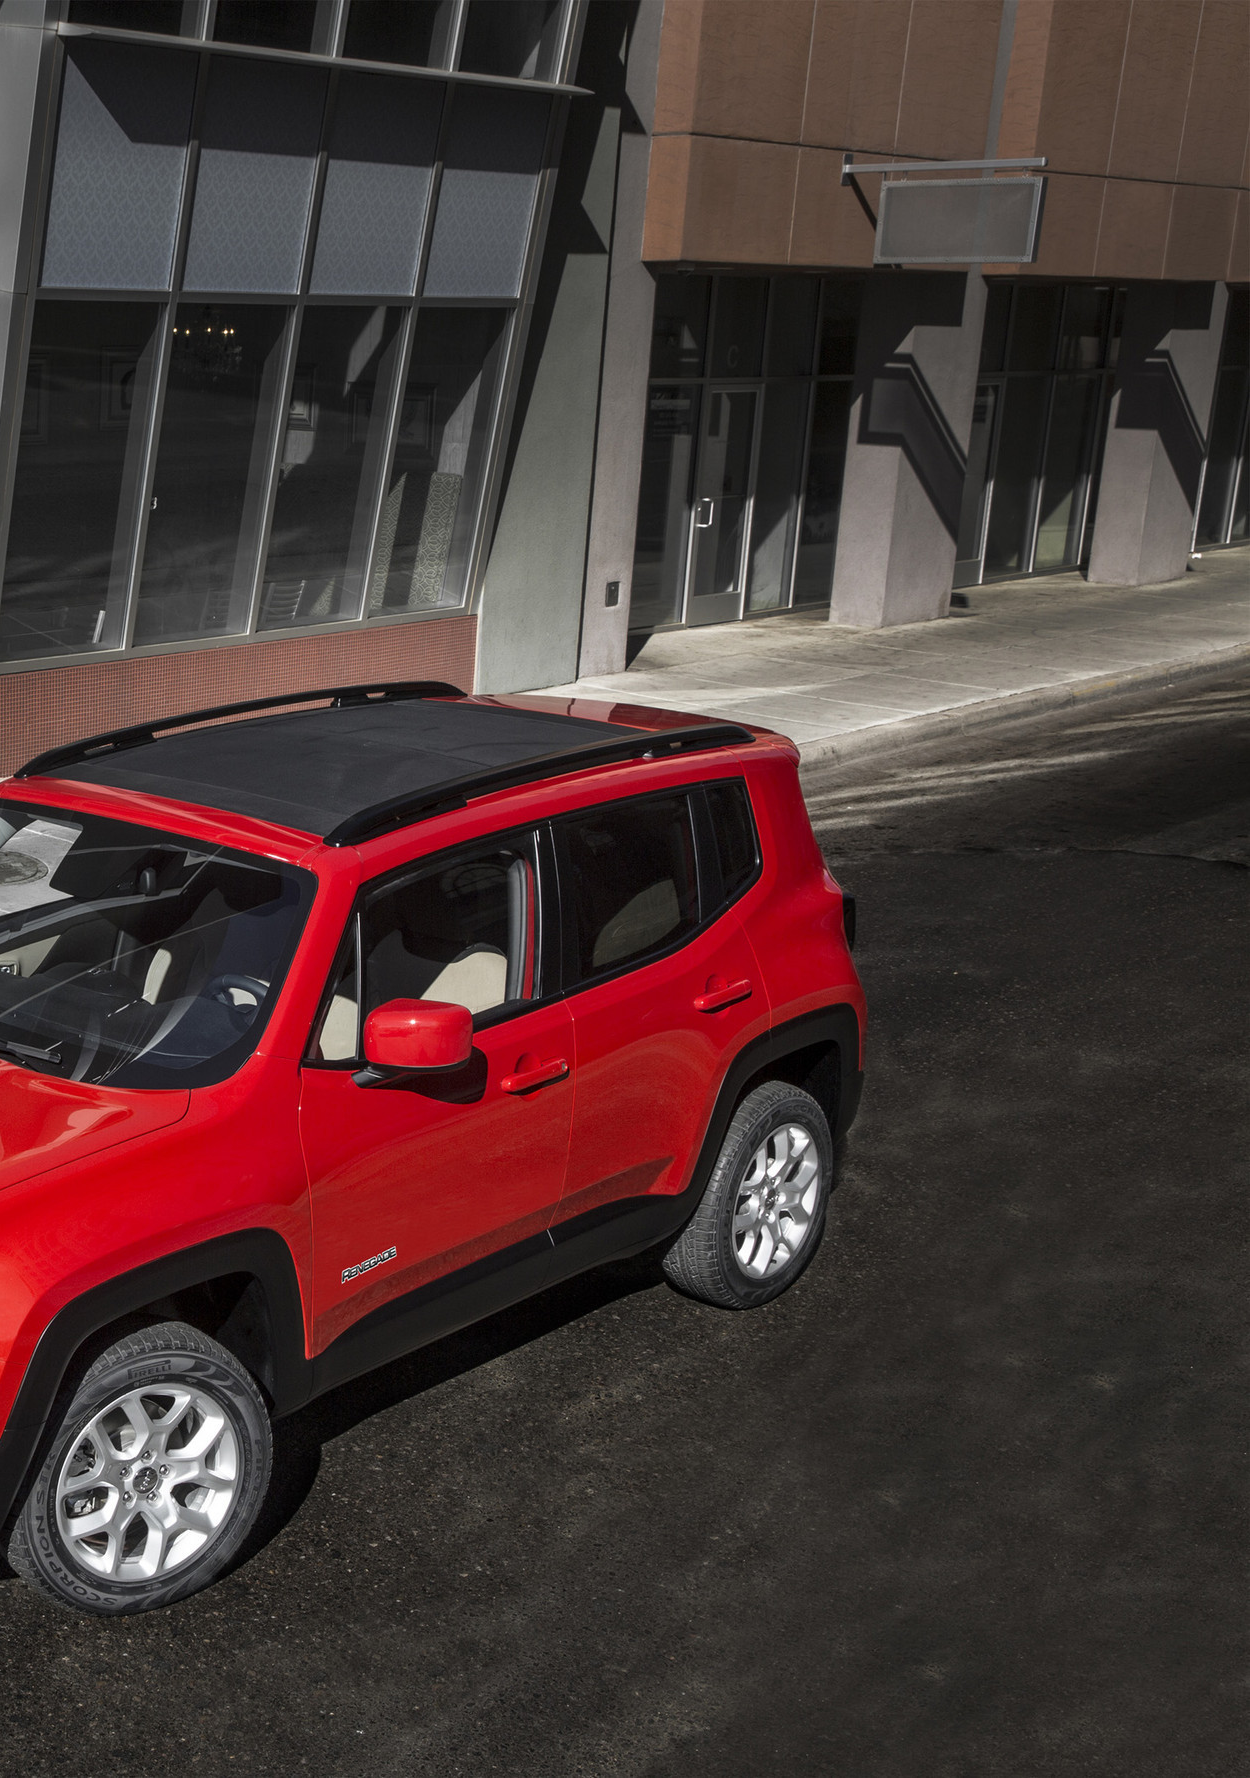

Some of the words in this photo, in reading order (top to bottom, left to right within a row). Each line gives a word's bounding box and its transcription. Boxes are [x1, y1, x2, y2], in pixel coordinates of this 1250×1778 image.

[341, 1246, 397, 1284] RENEGADE
[127, 1359, 172, 1379] PIRELLI
[35, 1515, 119, 1606] SCORPION
